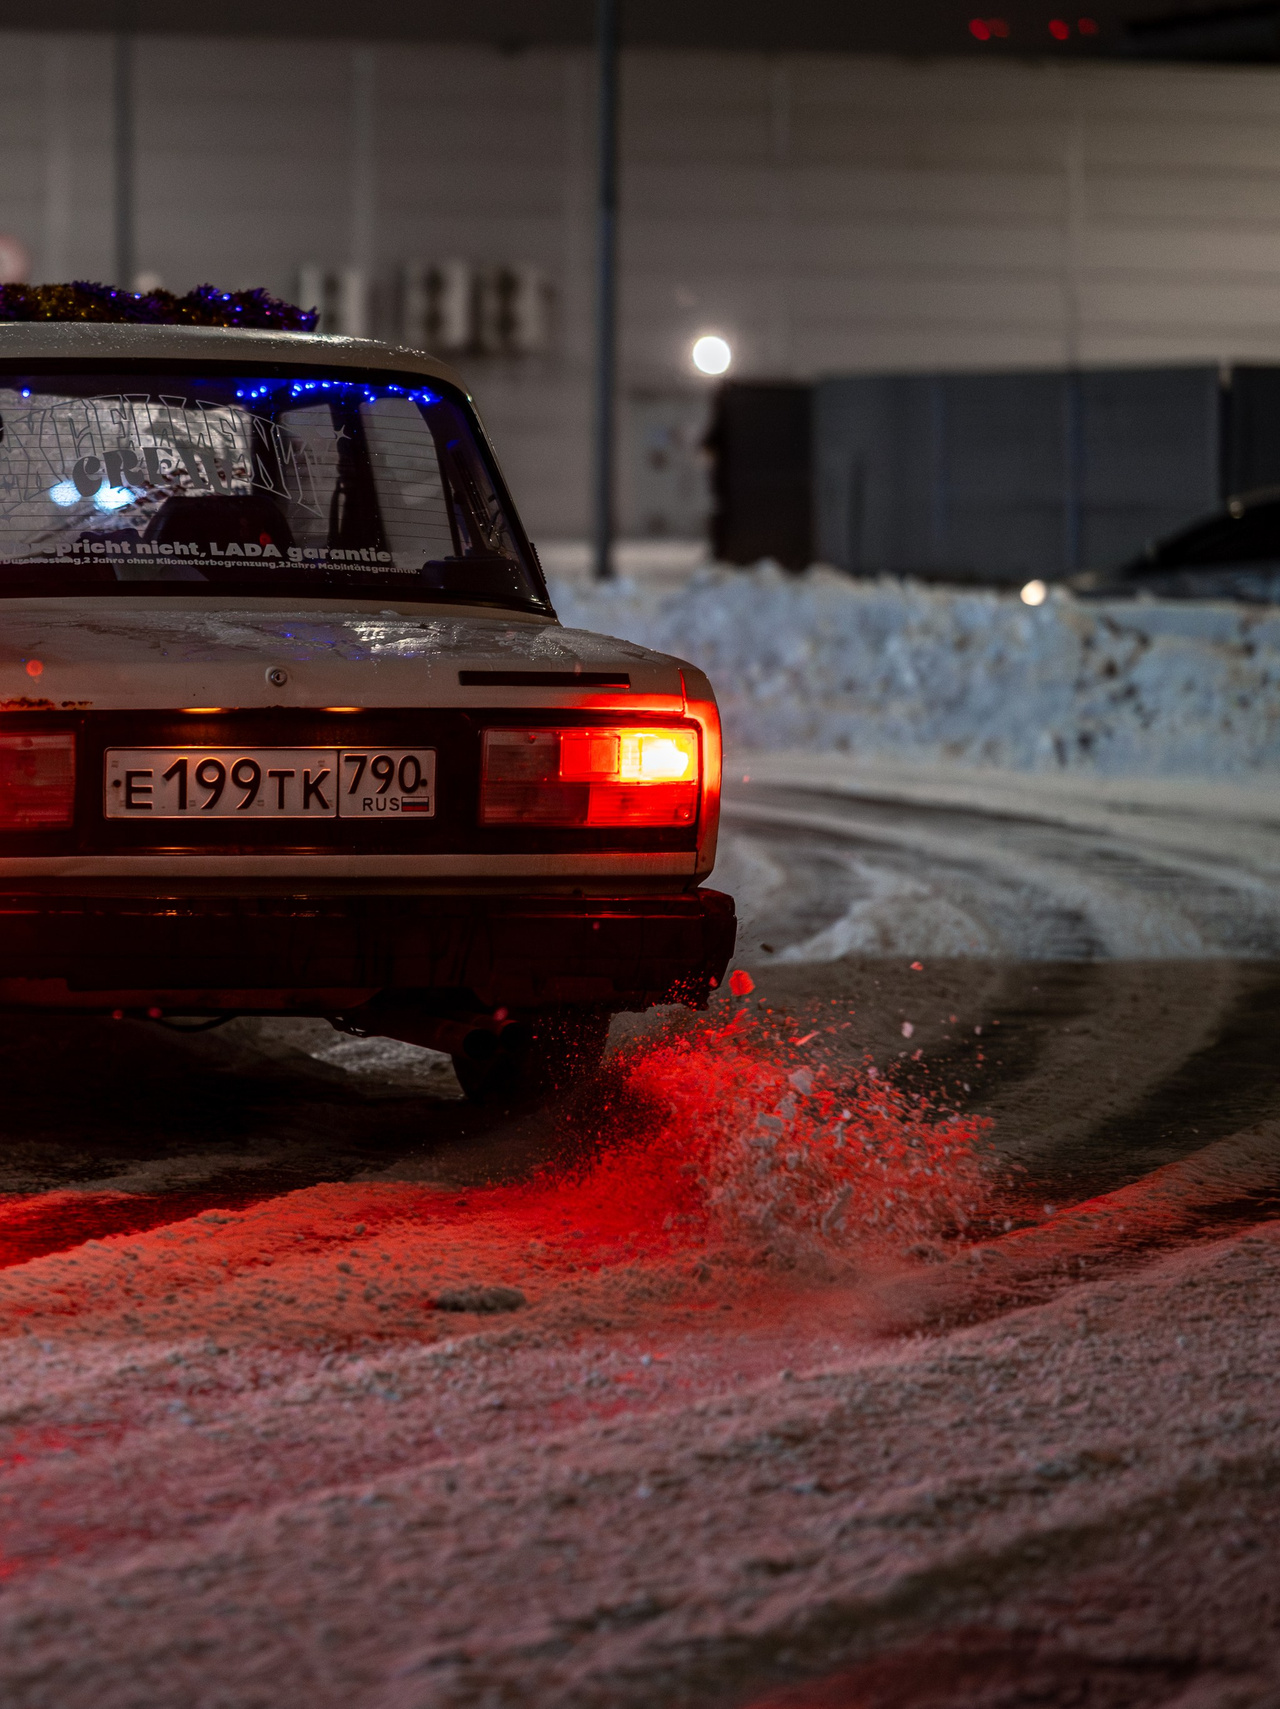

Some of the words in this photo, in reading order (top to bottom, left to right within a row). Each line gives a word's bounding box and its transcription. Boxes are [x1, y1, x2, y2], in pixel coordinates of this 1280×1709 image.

[135, 540, 206, 557] nicht,
[209, 542, 283, 557] LADA
[343, 754, 422, 794] 790
[362, 797, 400, 812] RUS
